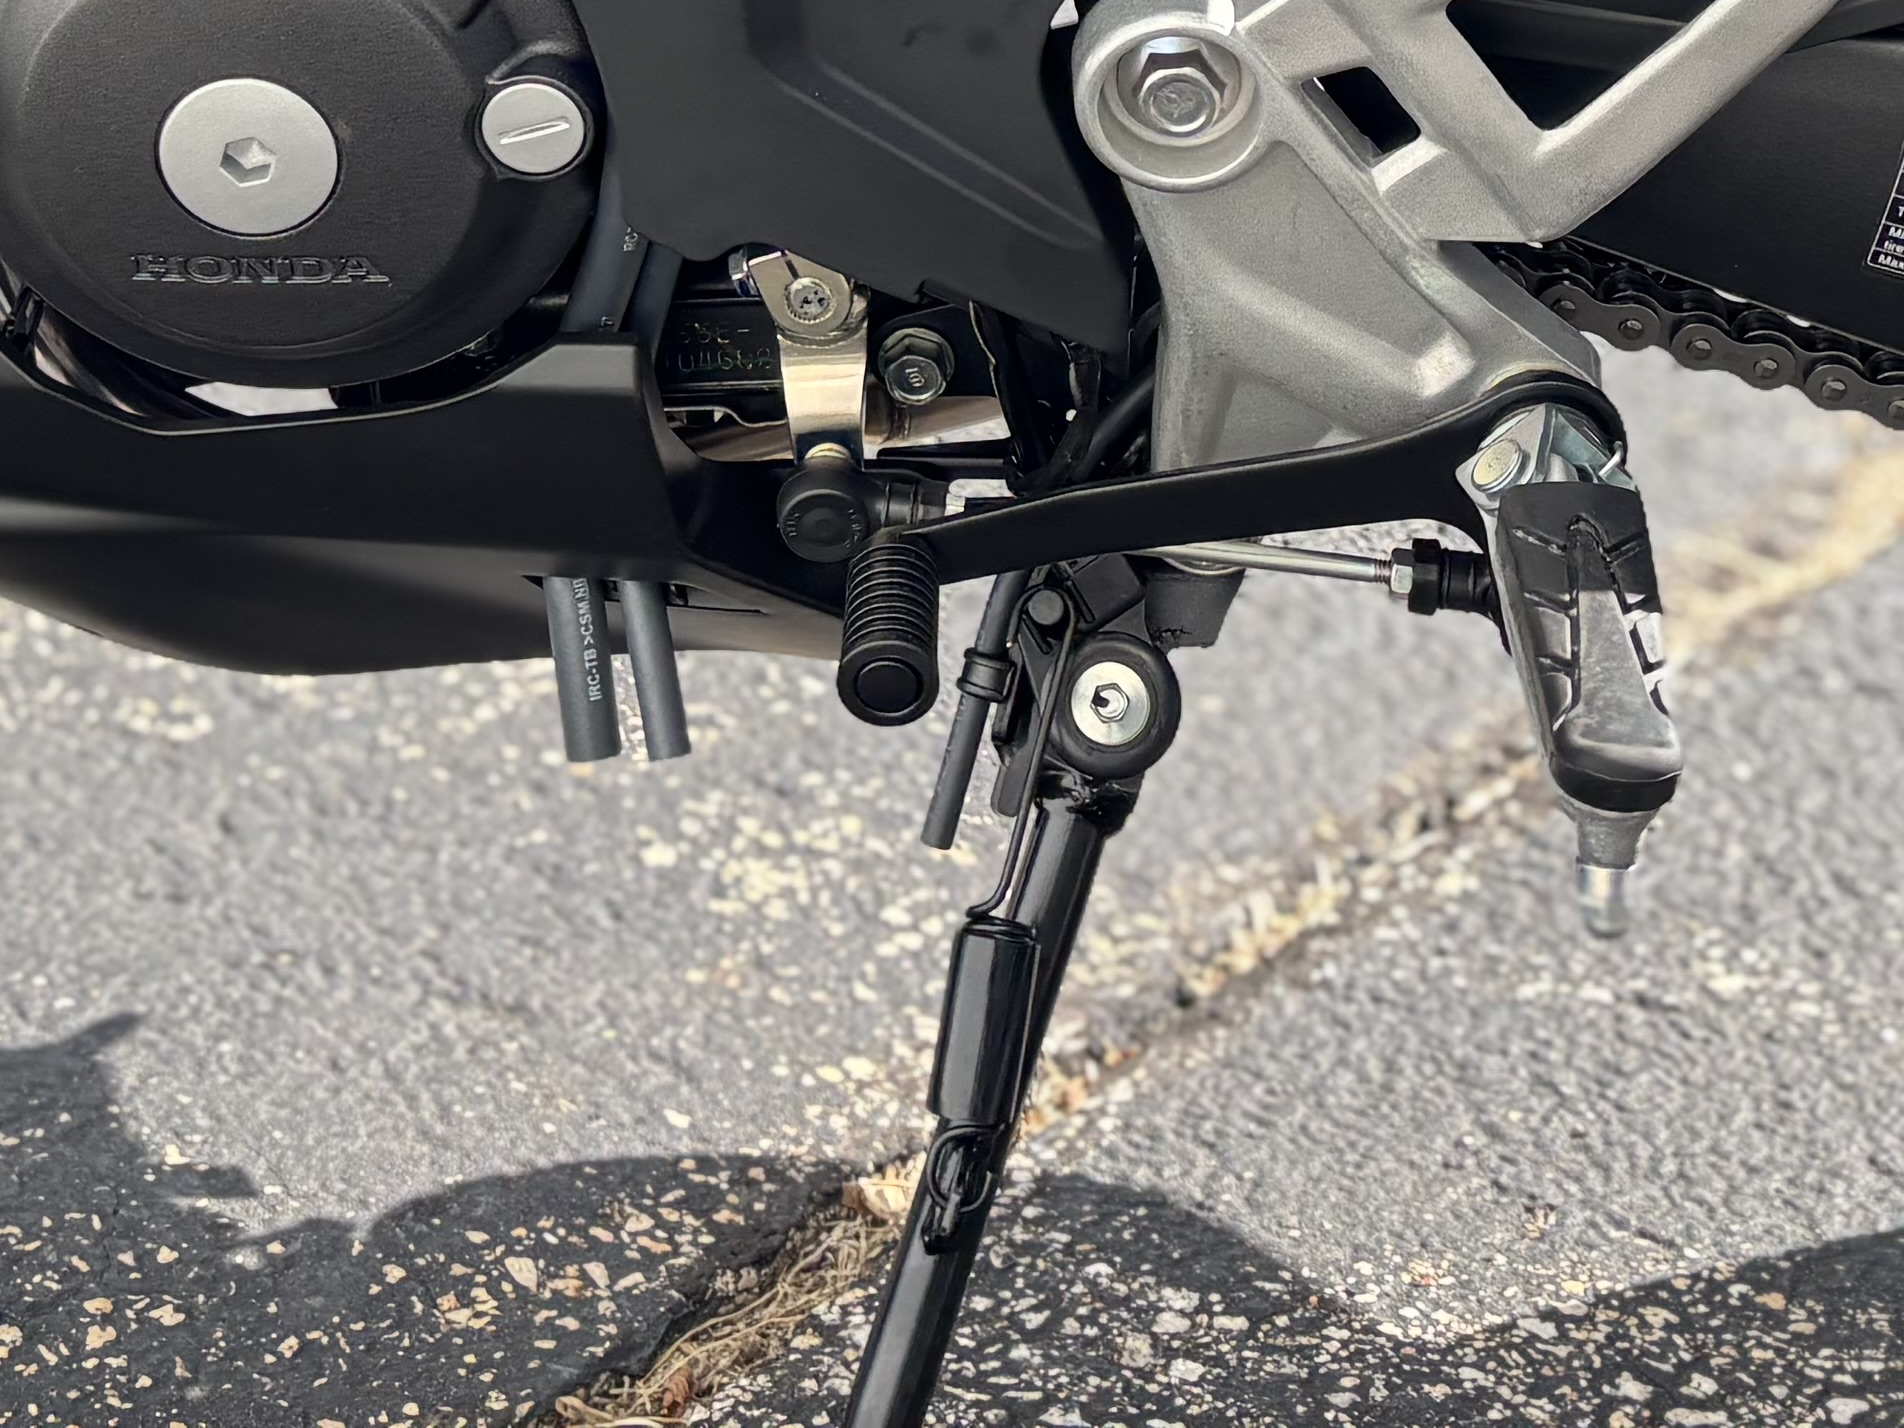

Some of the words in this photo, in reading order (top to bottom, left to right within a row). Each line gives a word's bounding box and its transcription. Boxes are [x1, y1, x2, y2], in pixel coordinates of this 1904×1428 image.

[1882, 239, 1904, 254] tire
[130, 254, 392, 285] HONDA
[580, 648, 604, 701] IRC-TB
